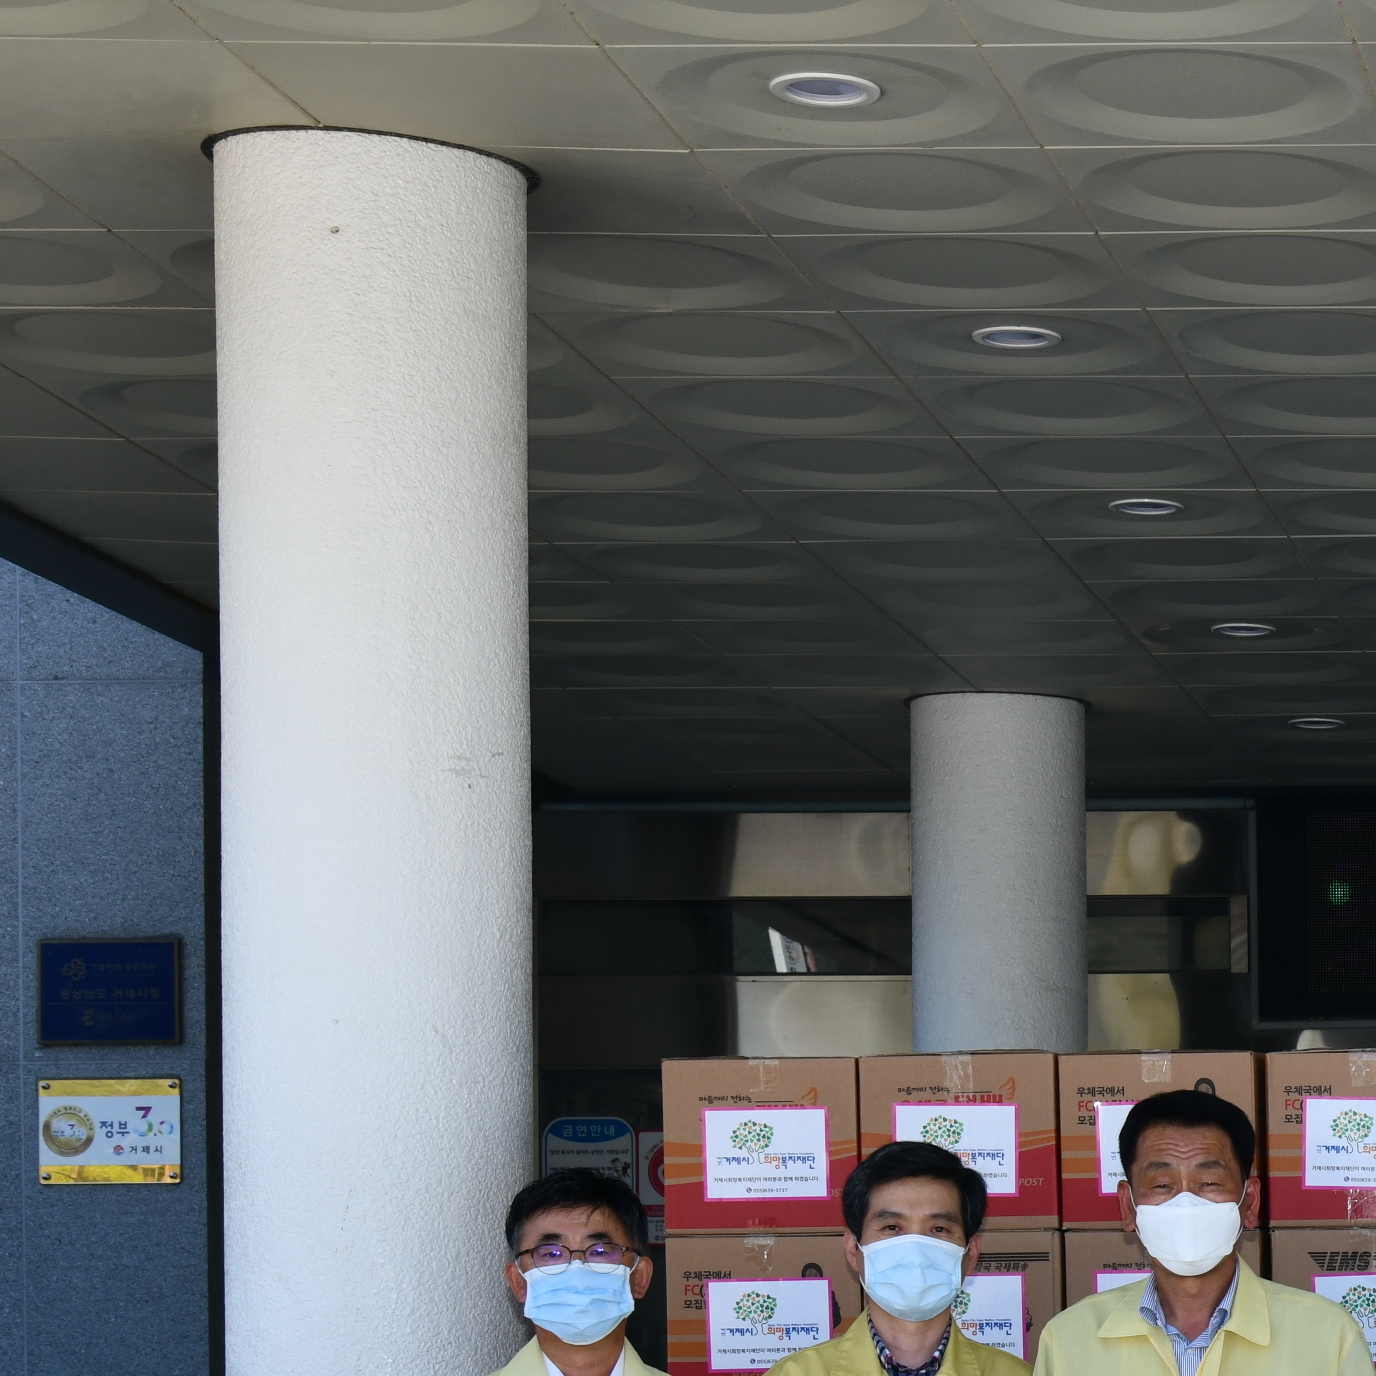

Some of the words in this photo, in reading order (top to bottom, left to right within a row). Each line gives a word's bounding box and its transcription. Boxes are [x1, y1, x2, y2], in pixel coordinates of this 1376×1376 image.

[60, 988, 106, 1000] 경상남도
[113, 988, 160, 1000] 거제시청
[1077, 1086, 1125, 1097] 우체국에서
[1283, 1085, 1332, 1096] 우체국에서
[562, 1124, 615, 1137] 금연안내
[129, 1145, 163, 1154] 거제시
[1322, 1145, 1349, 1154] 거제시
[722, 1156, 750, 1166] 거제시
[763, 1155, 816, 1170] 희망복지재단
[1019, 1177, 1044, 1187] POST
[974, 1263, 990, 1273] 체국
[994, 1262, 1028, 1272] 국제특송
[683, 1271, 731, 1280] 우체국에서
[727, 1327, 753, 1336] 거제시
[767, 1327, 819, 1340] 희망복지재단
[961, 1322, 1012, 1335] 희망복지재단
